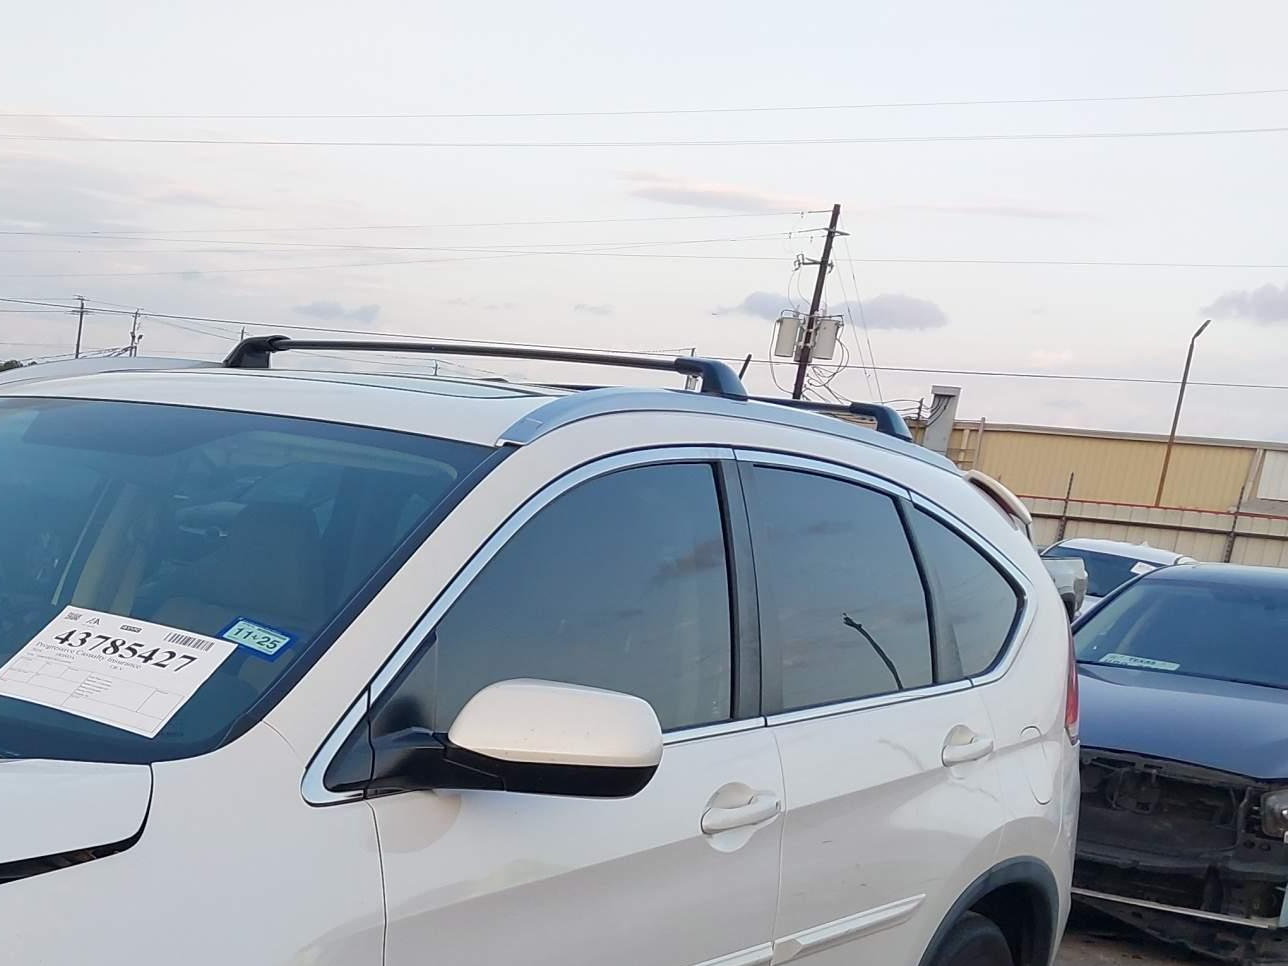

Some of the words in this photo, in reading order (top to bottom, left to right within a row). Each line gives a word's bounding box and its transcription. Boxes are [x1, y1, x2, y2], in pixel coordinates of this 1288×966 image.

[36, 641, 75, 654] Progressive
[76, 649, 106, 662] Casualty
[107, 657, 142, 670] Insurance
[53, 628, 198, 673] 43785427
